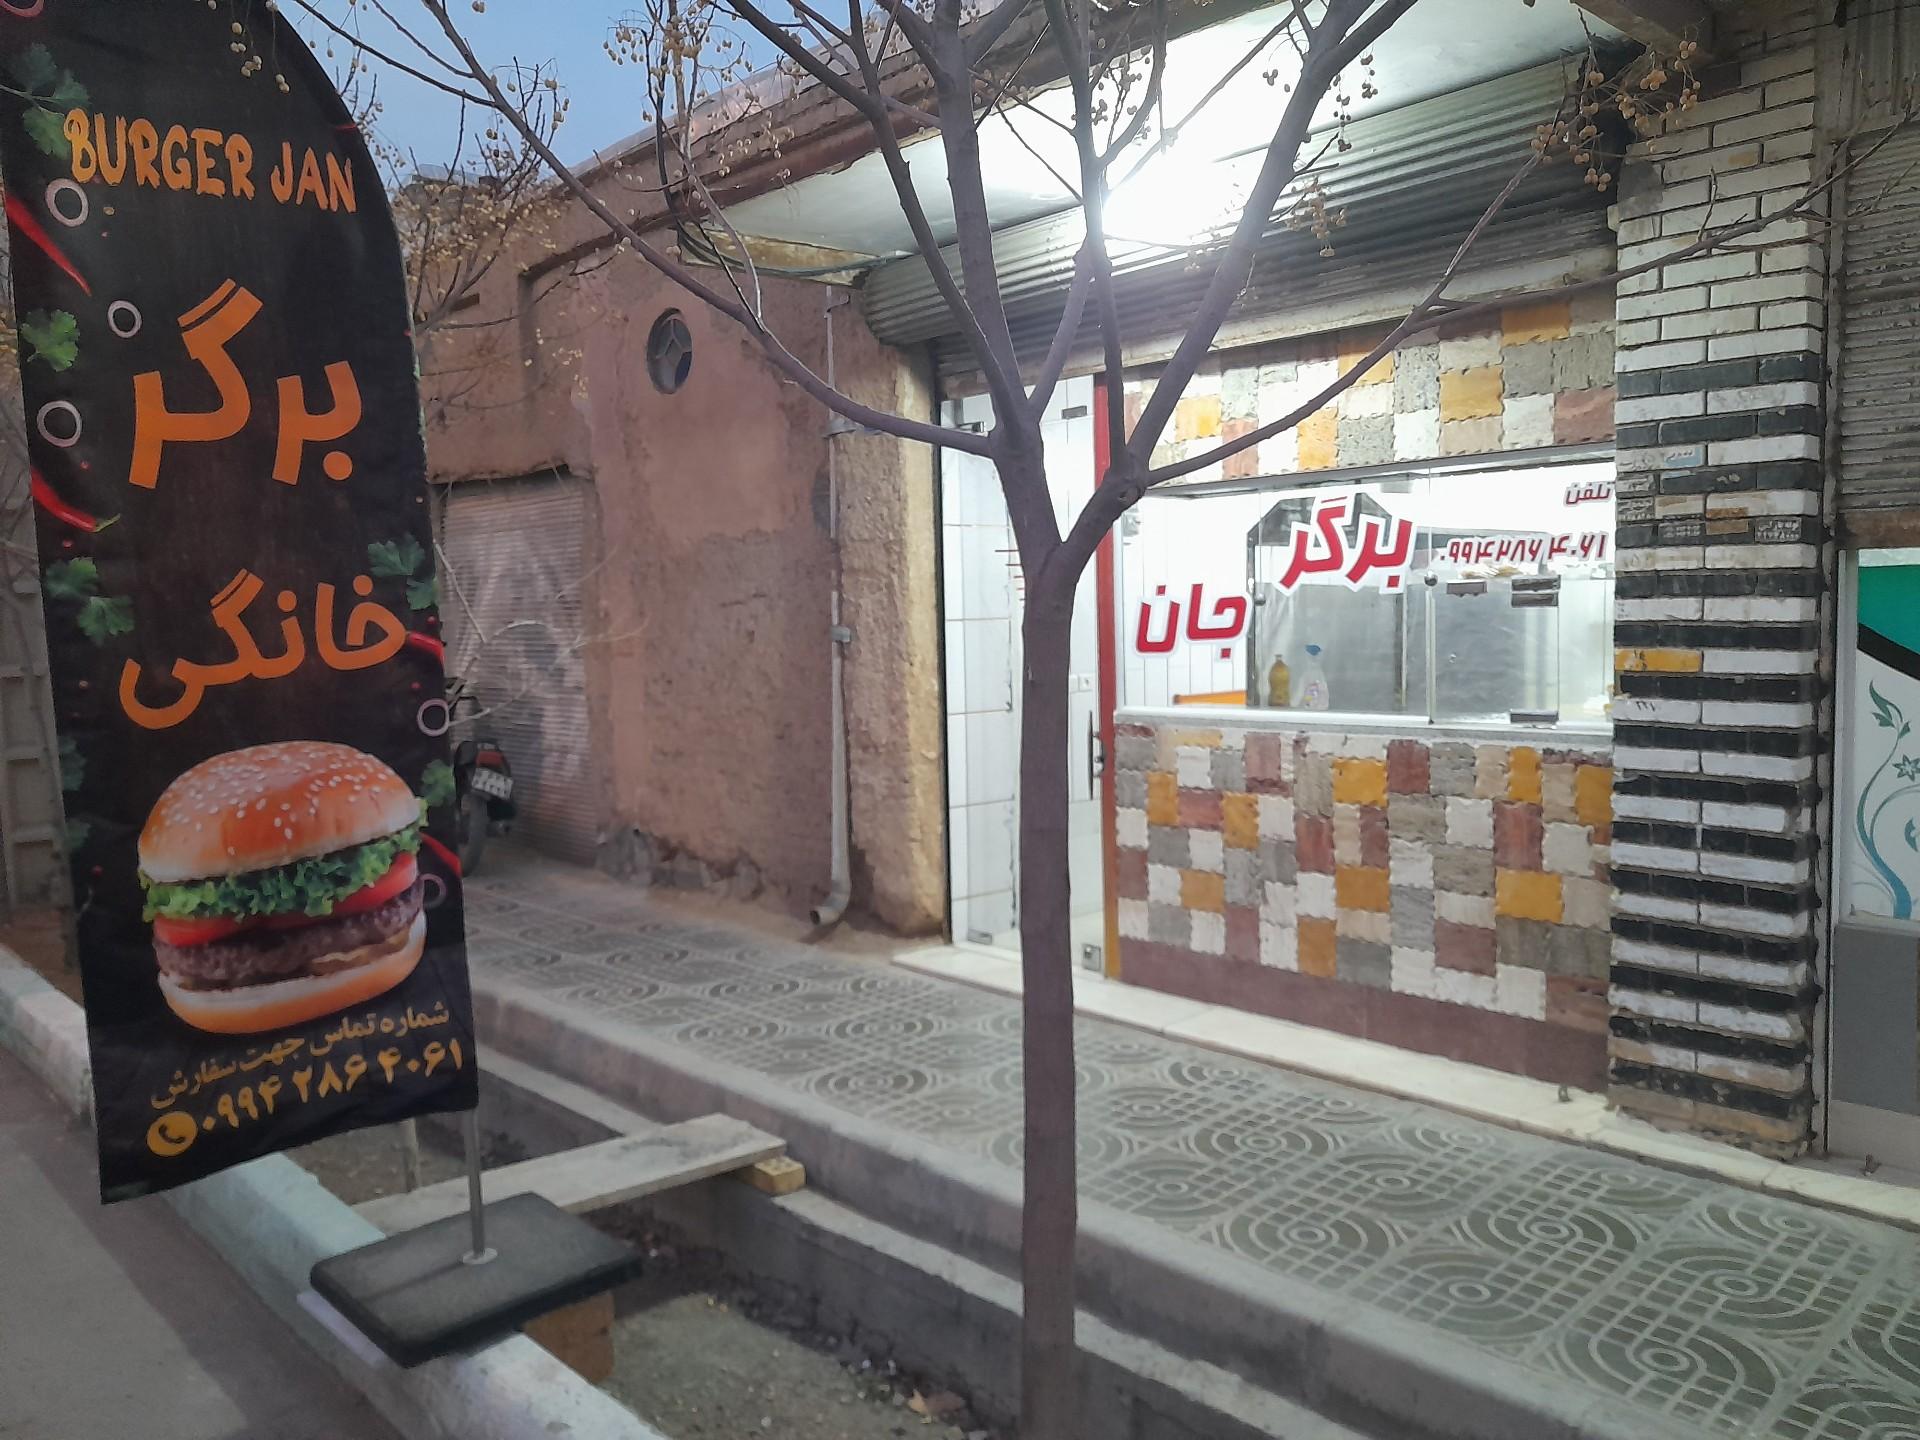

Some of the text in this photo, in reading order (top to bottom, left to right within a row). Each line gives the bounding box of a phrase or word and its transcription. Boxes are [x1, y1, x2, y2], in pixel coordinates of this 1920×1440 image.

[64, 107, 356, 213] BURGER JAN
[129, 278, 363, 489] برگر
[1565, 481, 1616, 505] تلفن
[1136, 496, 1413, 659] برگر جان
[119, 569, 406, 730] خانگی
[151, 1001, 450, 1110] شماره تماس جهت سفارش
[202, 1038, 463, 1131] ۰۹۹۴ ۲۸۶ ۴۰۶۱
